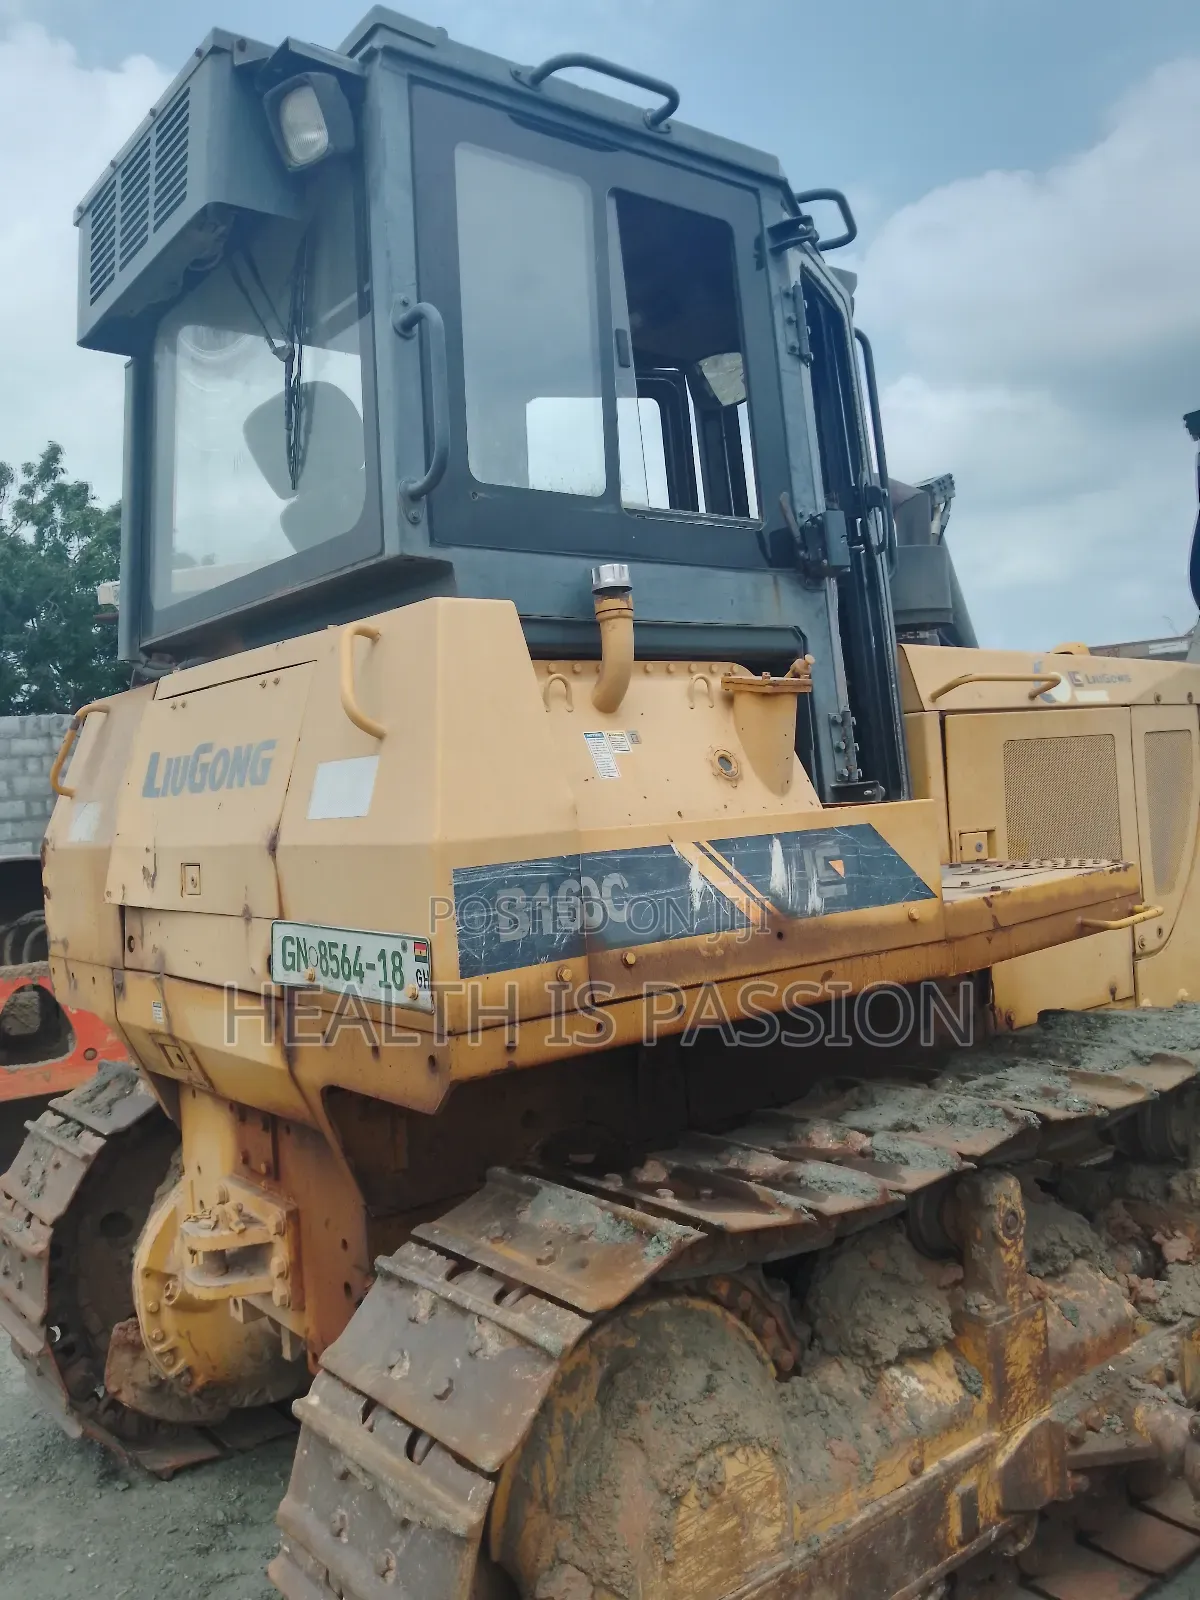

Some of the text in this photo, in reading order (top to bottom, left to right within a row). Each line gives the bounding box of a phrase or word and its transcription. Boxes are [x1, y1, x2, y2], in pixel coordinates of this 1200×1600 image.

[281, 935, 405, 991] GN 8564-18
[415, 968, 429, 989] GH
